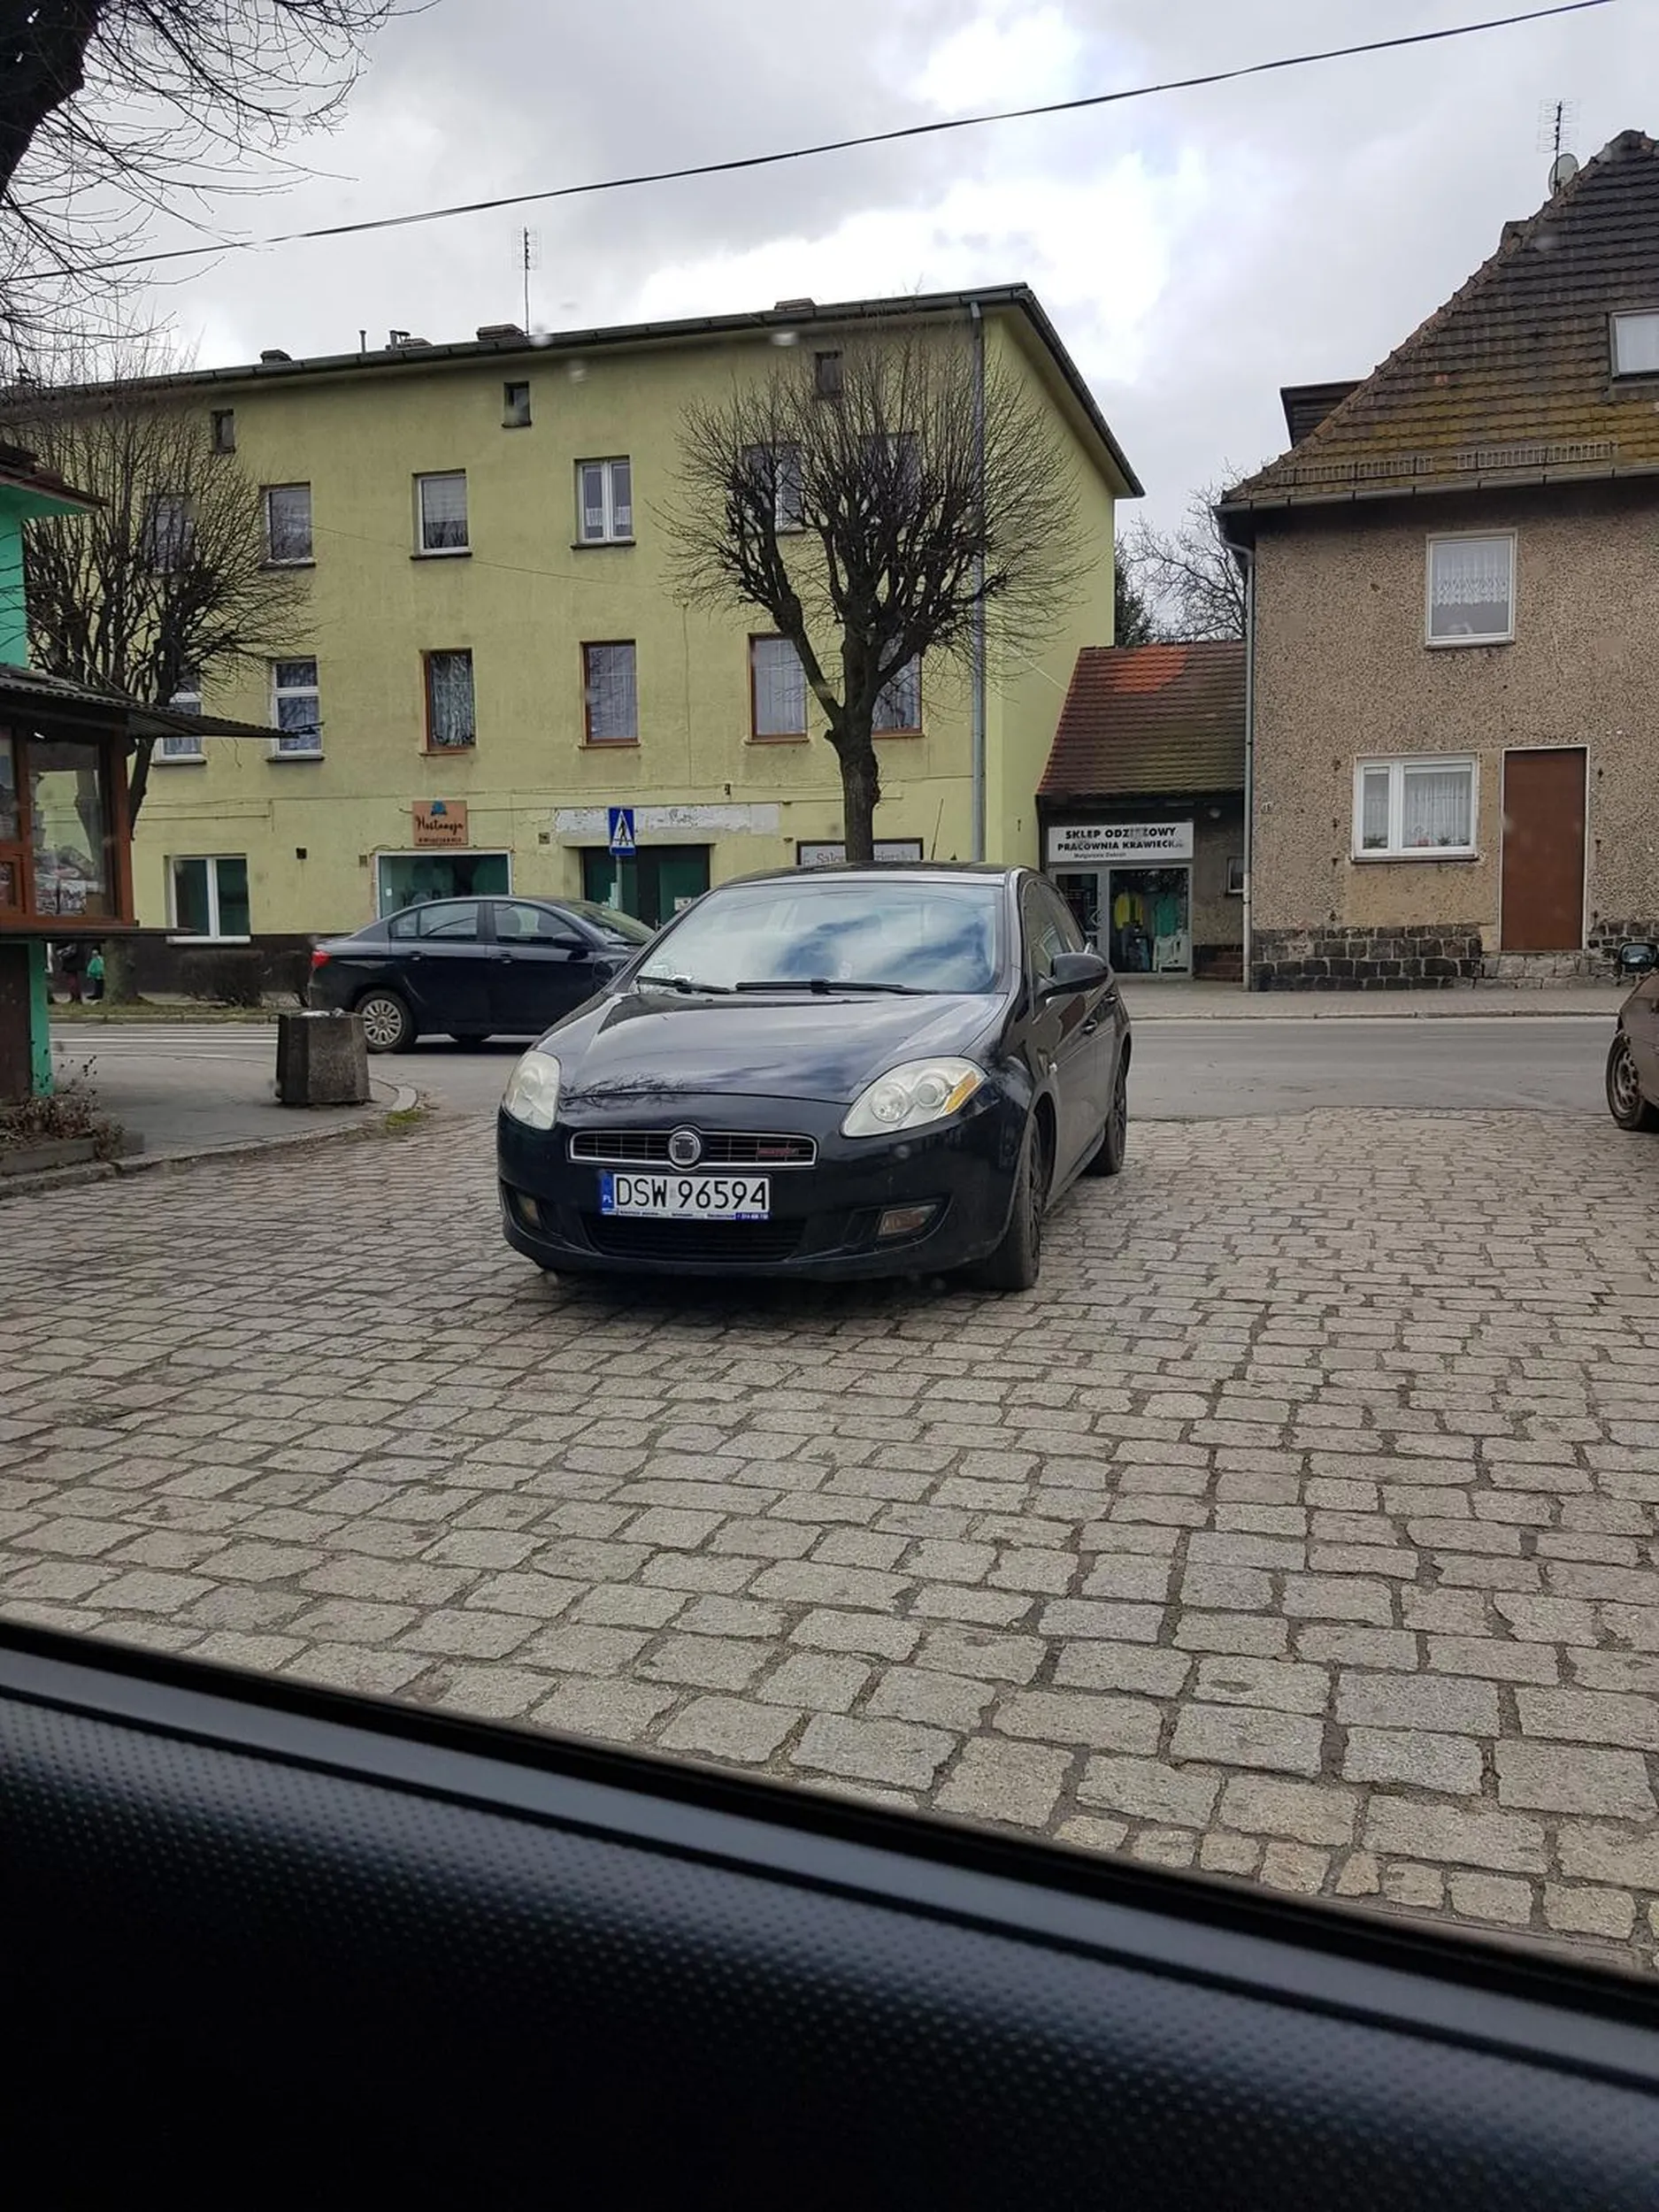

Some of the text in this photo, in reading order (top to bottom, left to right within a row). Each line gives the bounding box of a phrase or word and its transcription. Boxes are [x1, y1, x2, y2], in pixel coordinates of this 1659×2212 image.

[1065, 829, 1101, 840] SKLEP
[1057, 841, 1119, 851] PRACOWNIA
[616, 1178, 766, 1210] DSW 96594
